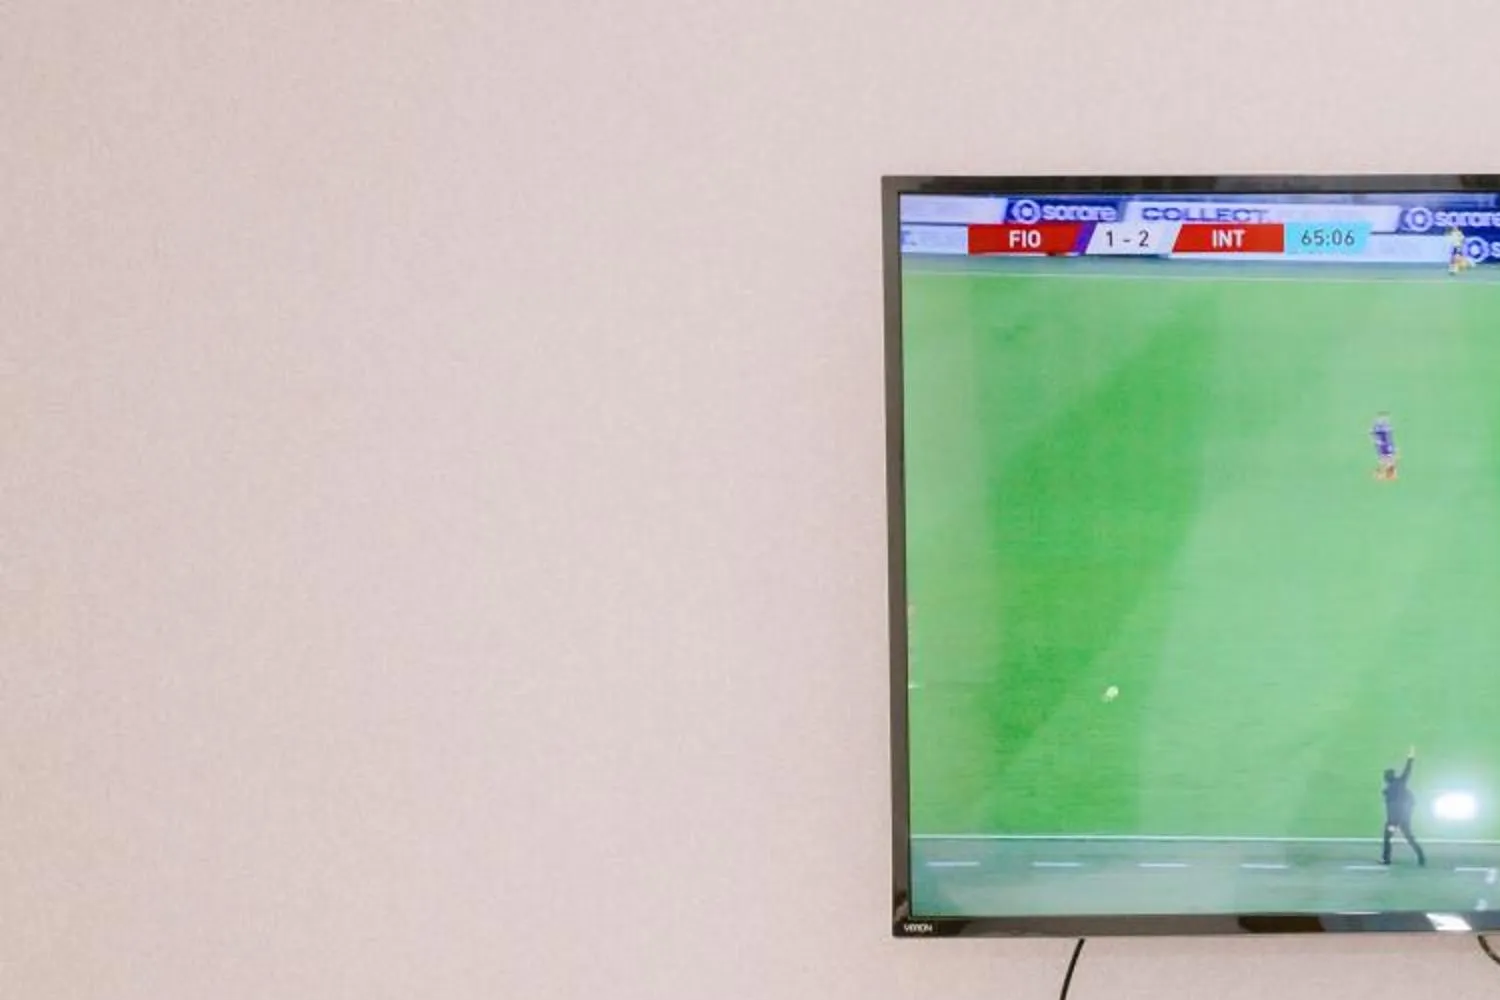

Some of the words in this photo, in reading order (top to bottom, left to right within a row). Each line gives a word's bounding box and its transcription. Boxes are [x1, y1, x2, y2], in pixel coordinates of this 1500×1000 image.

[1009, 230, 1041, 248] FIO
[1139, 230, 1149, 247] 2
[1211, 229, 1245, 248] INT
[1301, 229, 1355, 246] 65:06
